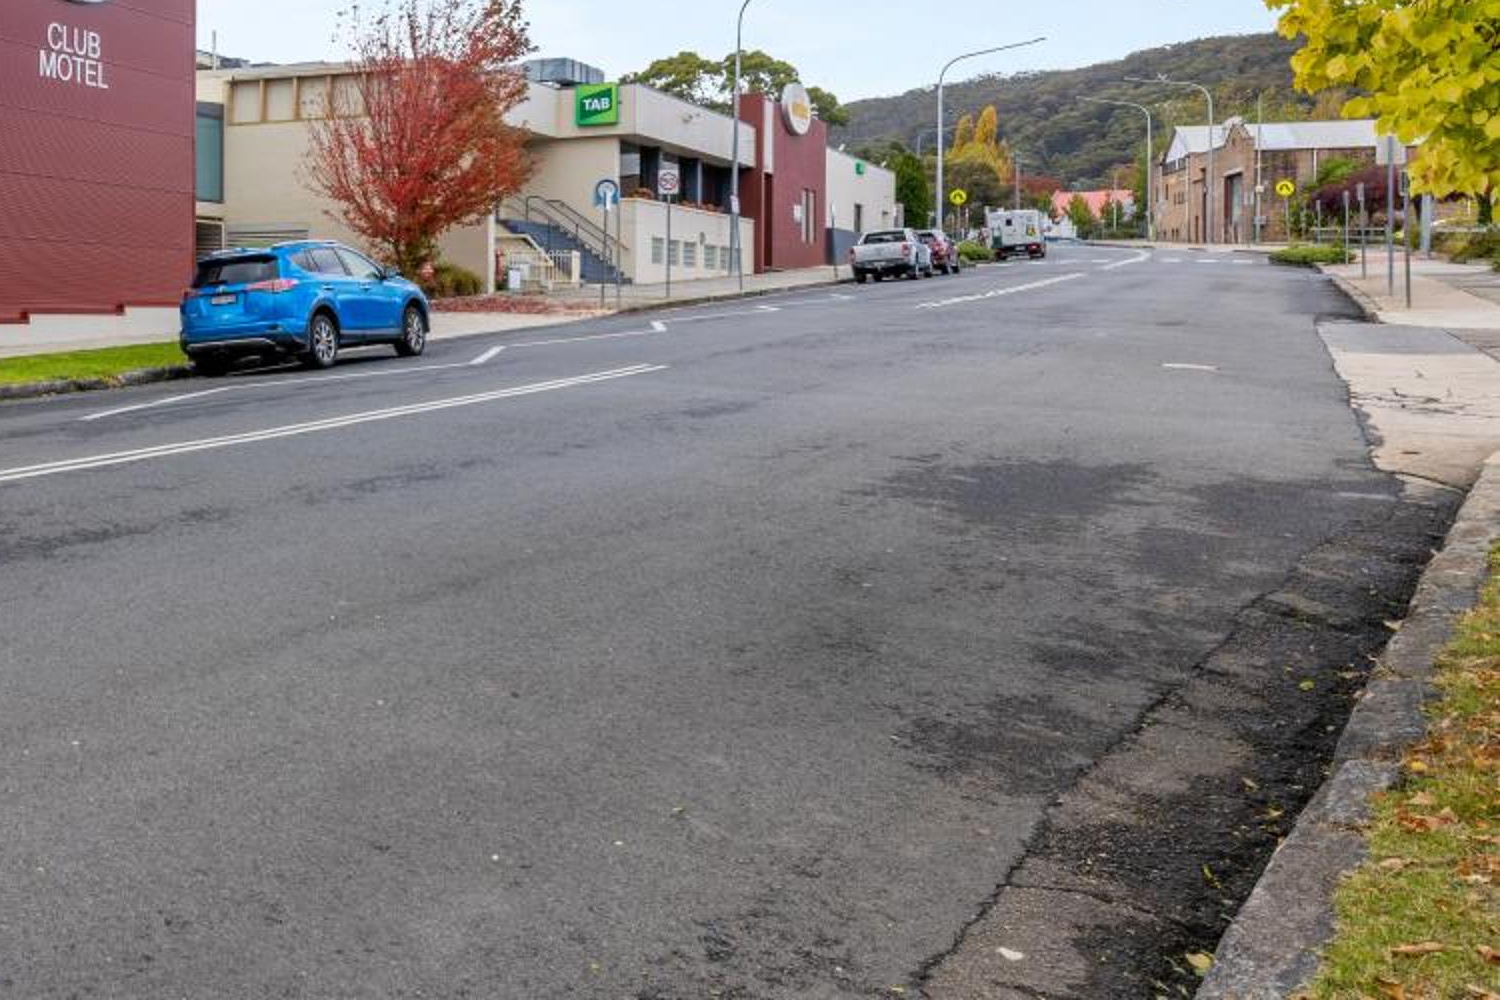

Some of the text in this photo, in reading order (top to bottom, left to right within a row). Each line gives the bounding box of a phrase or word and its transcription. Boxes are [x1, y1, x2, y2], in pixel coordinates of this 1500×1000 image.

[47, 23, 101, 59] CLUB
[39, 50, 109, 89] MOTEL
[583, 98, 610, 110] TAB
